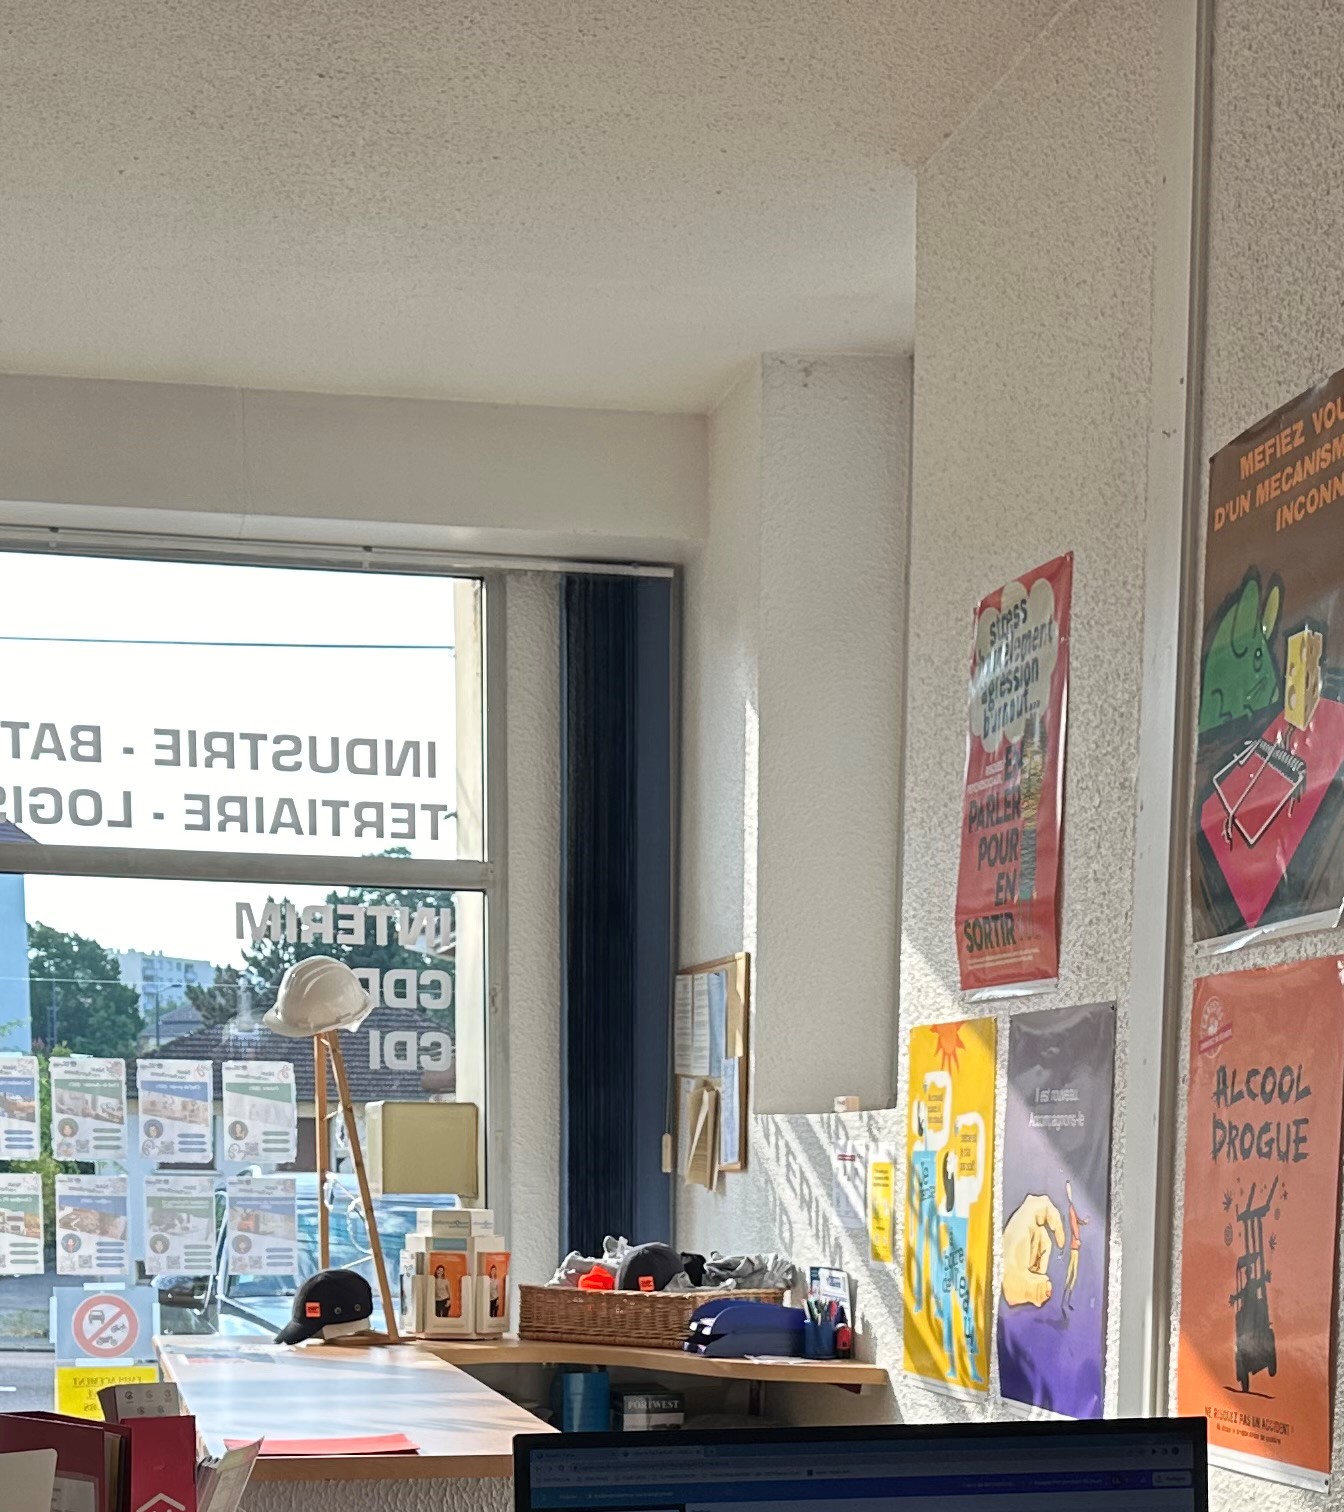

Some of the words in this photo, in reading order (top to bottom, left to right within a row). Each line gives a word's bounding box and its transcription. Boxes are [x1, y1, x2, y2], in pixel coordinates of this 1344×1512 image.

[1239, 419, 1306, 481] MEFIEZ
[1213, 488, 1251, 531] D'UN
[989, 598, 1028, 647] stress
[968, 784, 1020, 833] PARLER
[978, 828, 1018, 870] POUR
[994, 869, 1017, 906] EN
[964, 911, 1017, 953] SORTIR
[1213, 1064, 1312, 1107] ALCOOL
[1211, 1117, 1309, 1163] DROGUE
